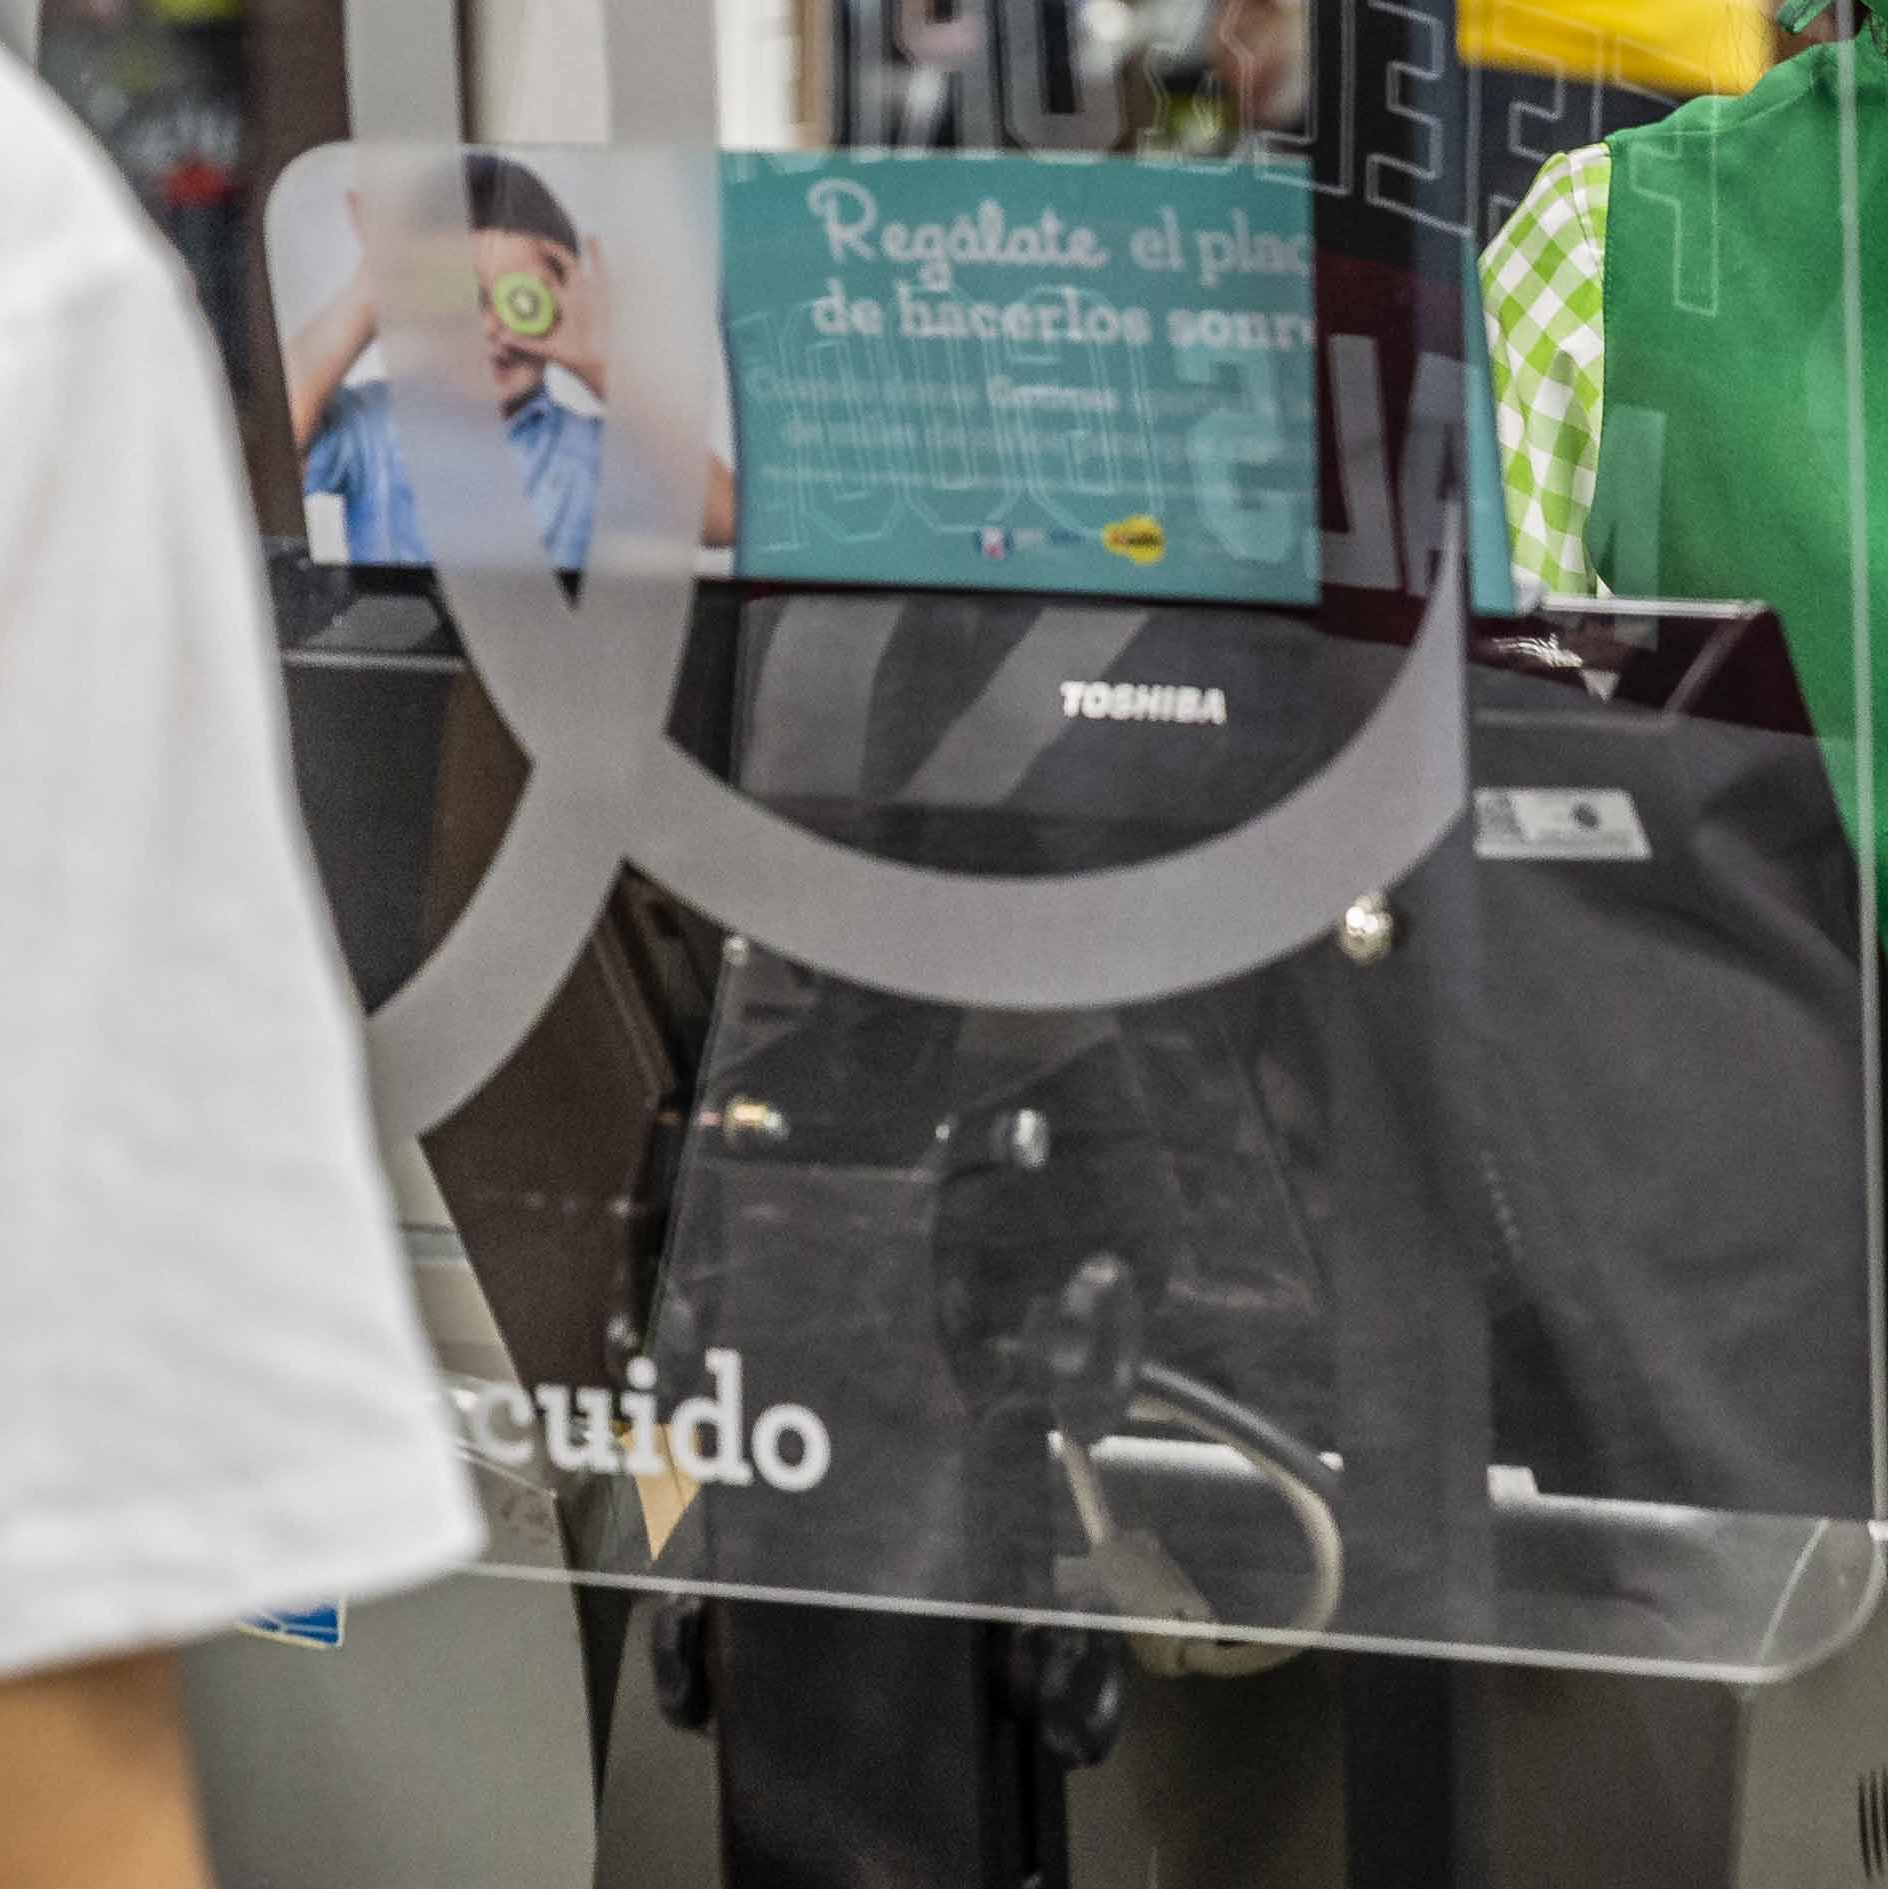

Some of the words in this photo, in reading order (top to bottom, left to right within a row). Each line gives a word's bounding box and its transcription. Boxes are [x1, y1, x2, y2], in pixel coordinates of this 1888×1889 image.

[1129, 206, 1185, 272] el
[811, 278, 881, 338] de
[895, 278, 1153, 345] hacerlos
[1060, 680, 1228, 725] TOSHIBA
